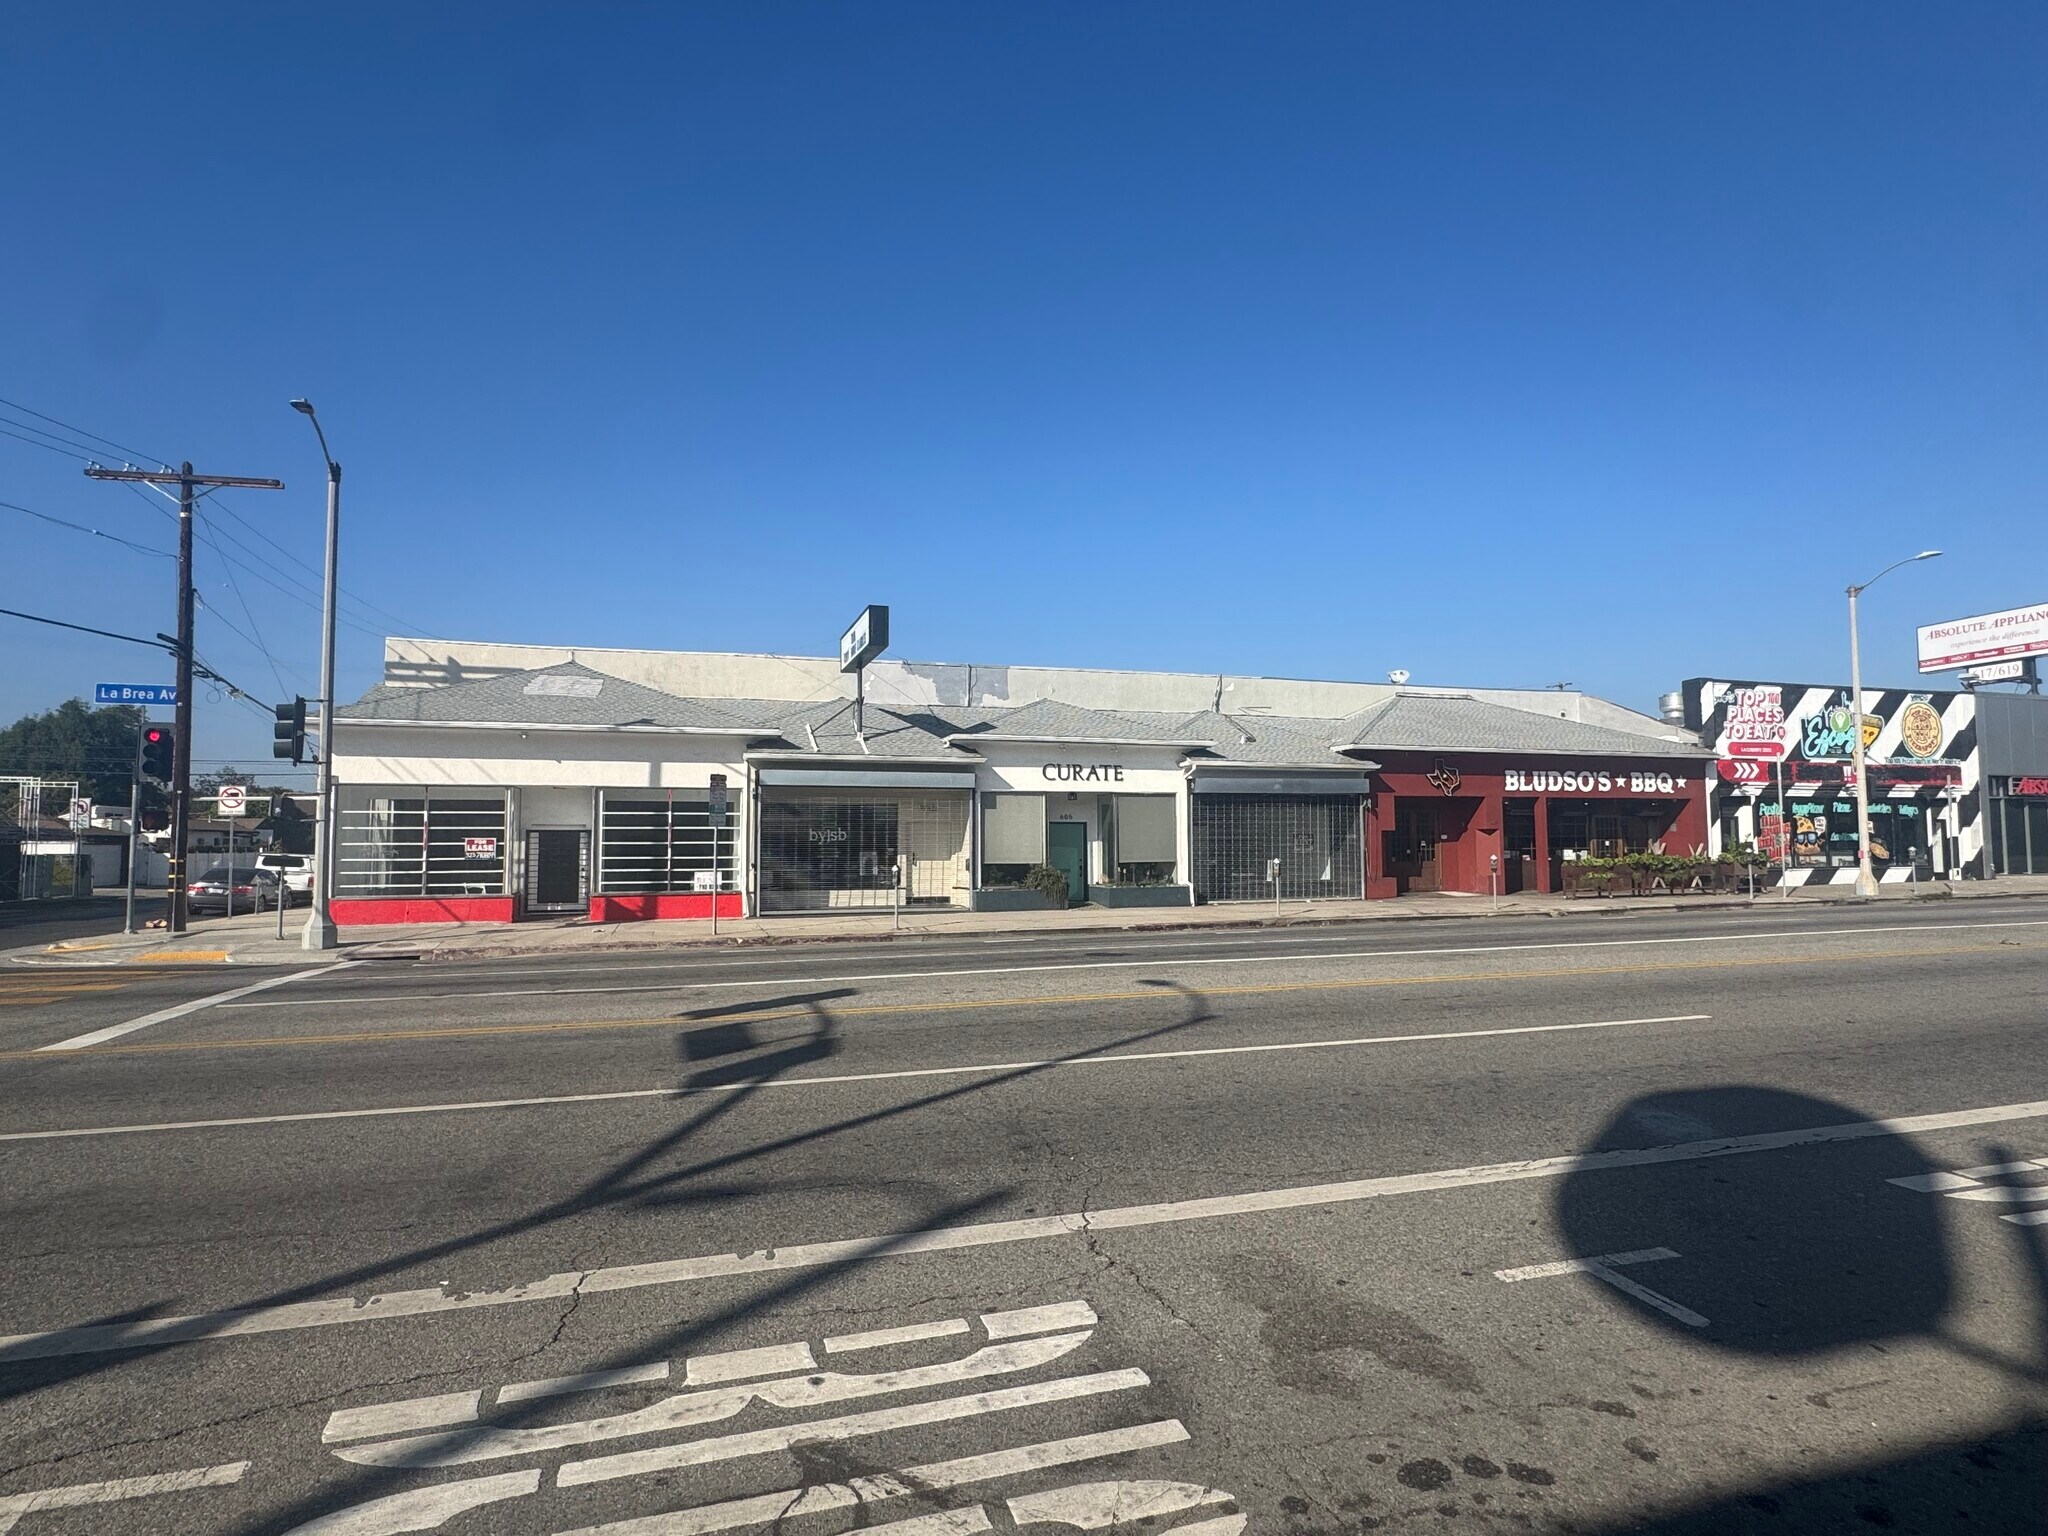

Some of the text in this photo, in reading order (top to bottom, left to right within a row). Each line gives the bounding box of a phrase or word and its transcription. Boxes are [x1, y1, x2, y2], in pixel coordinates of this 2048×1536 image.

[1925, 611, 2048, 641] ABSOLUTE APPLIAN
[1950, 629, 2040, 648] experience the difference
[101, 687, 118, 698] La
[123, 688, 154, 699] Brea
[1735, 689, 1765, 706] TOP
[1727, 705, 1783, 723] PLACES
[1724, 722, 1744, 739] TO
[1042, 763, 1124, 781] CURATE
[1505, 770, 1675, 793] BLUDSO'S BBQ
